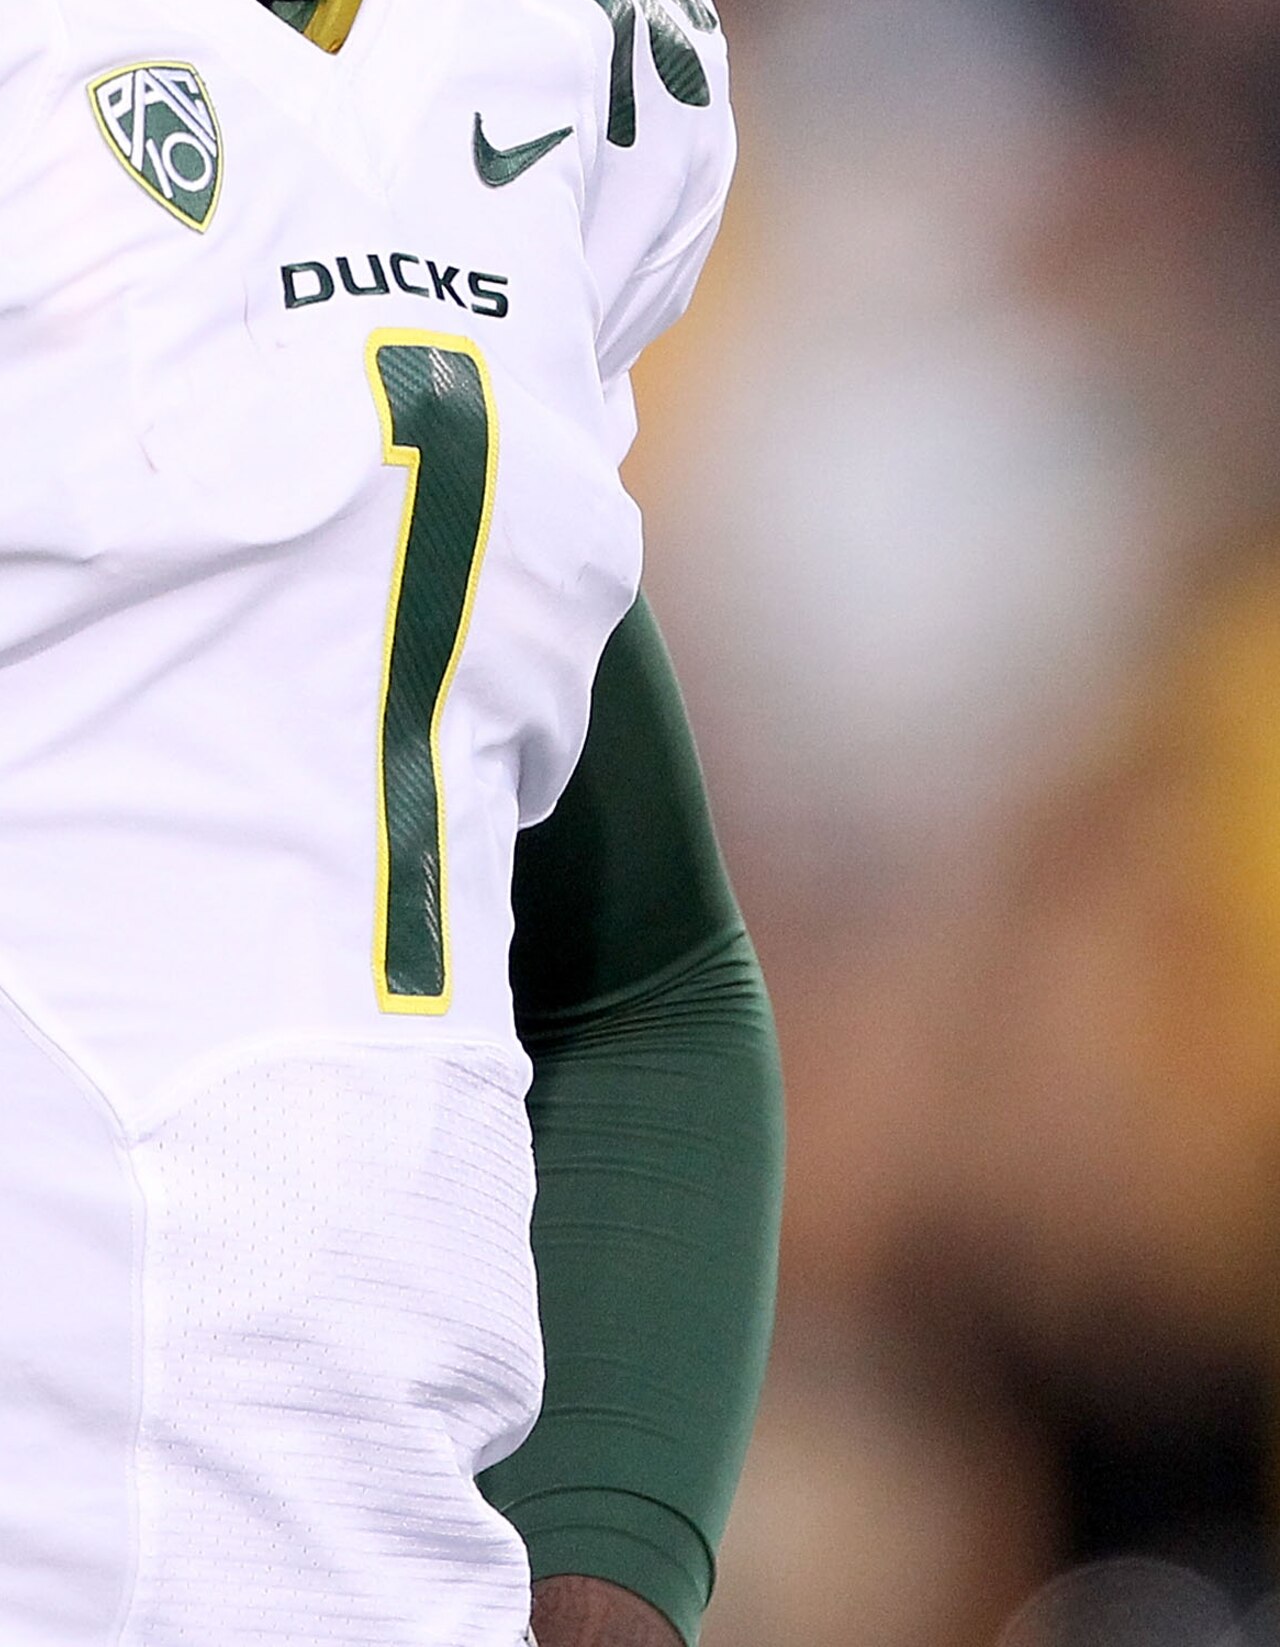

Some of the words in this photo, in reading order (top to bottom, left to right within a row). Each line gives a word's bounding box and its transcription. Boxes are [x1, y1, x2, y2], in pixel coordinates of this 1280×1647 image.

[94, 67, 219, 173] PAC
[145, 131, 214, 199] 10
[280, 252, 509, 319] DUCKS
[363, 326, 499, 1015] 1
